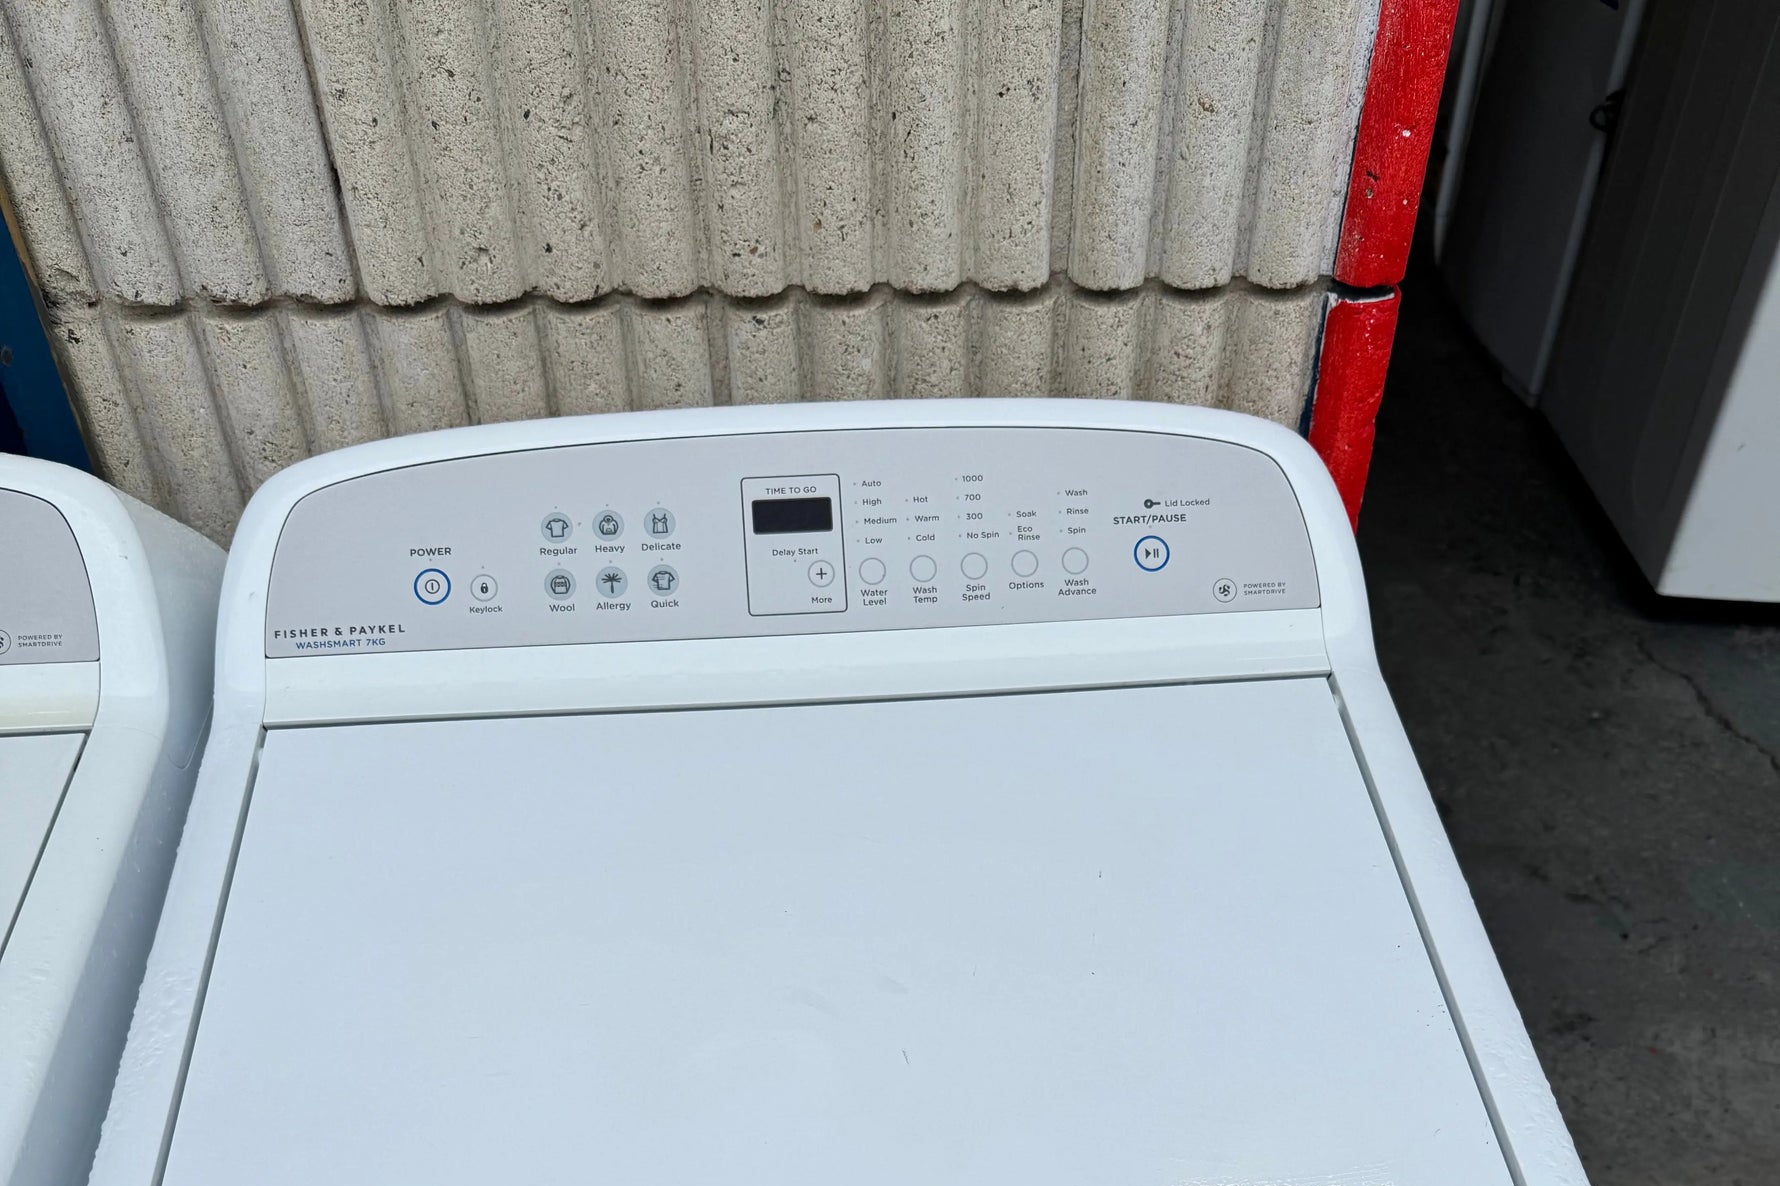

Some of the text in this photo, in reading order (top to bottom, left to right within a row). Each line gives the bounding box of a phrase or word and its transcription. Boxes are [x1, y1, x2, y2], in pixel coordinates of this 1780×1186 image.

[766, 487, 786, 495] TIME
[803, 486, 816, 494] GO
[1065, 488, 1088, 496] Wash
[862, 498, 882, 507] High
[1164, 498, 1210, 507] Lid Locked
[1016, 510, 1037, 518] Soak
[1066, 507, 1089, 515] Rinse
[864, 517, 897, 525] Medium
[914, 514, 939, 522] Warm
[1113, 514, 1187, 525] START/PAUSE
[1017, 525, 1033, 533] Eco
[1067, 526, 1086, 535] Spin
[916, 534, 935, 542] Cold
[967, 530, 1000, 540] No Spin
[1018, 533, 1040, 541] Rinse
[595, 544, 625, 555] Heavy
[641, 541, 681, 551] Delicate
[410, 547, 452, 557] POWER
[540, 546, 577, 557] Regular
[772, 547, 818, 557] Delay Start
[1008, 581, 1044, 590] Options
[1064, 578, 1089, 587] Wash
[860, 589, 888, 597] Water
[966, 584, 986, 593] Spin
[1058, 587, 1097, 596] Advance
[811, 596, 832, 604] More
[863, 598, 887, 606] Level
[913, 595, 938, 604] Temp
[962, 593, 991, 602] Speed
[549, 603, 576, 613] Wool
[595, 601, 632, 612] Allergy
[650, 598, 680, 609] Quick
[469, 605, 503, 615] Keylock
[274, 624, 406, 640] FISHER & PAYKEL
[296, 638, 386, 649] WASHSMART 7KG
